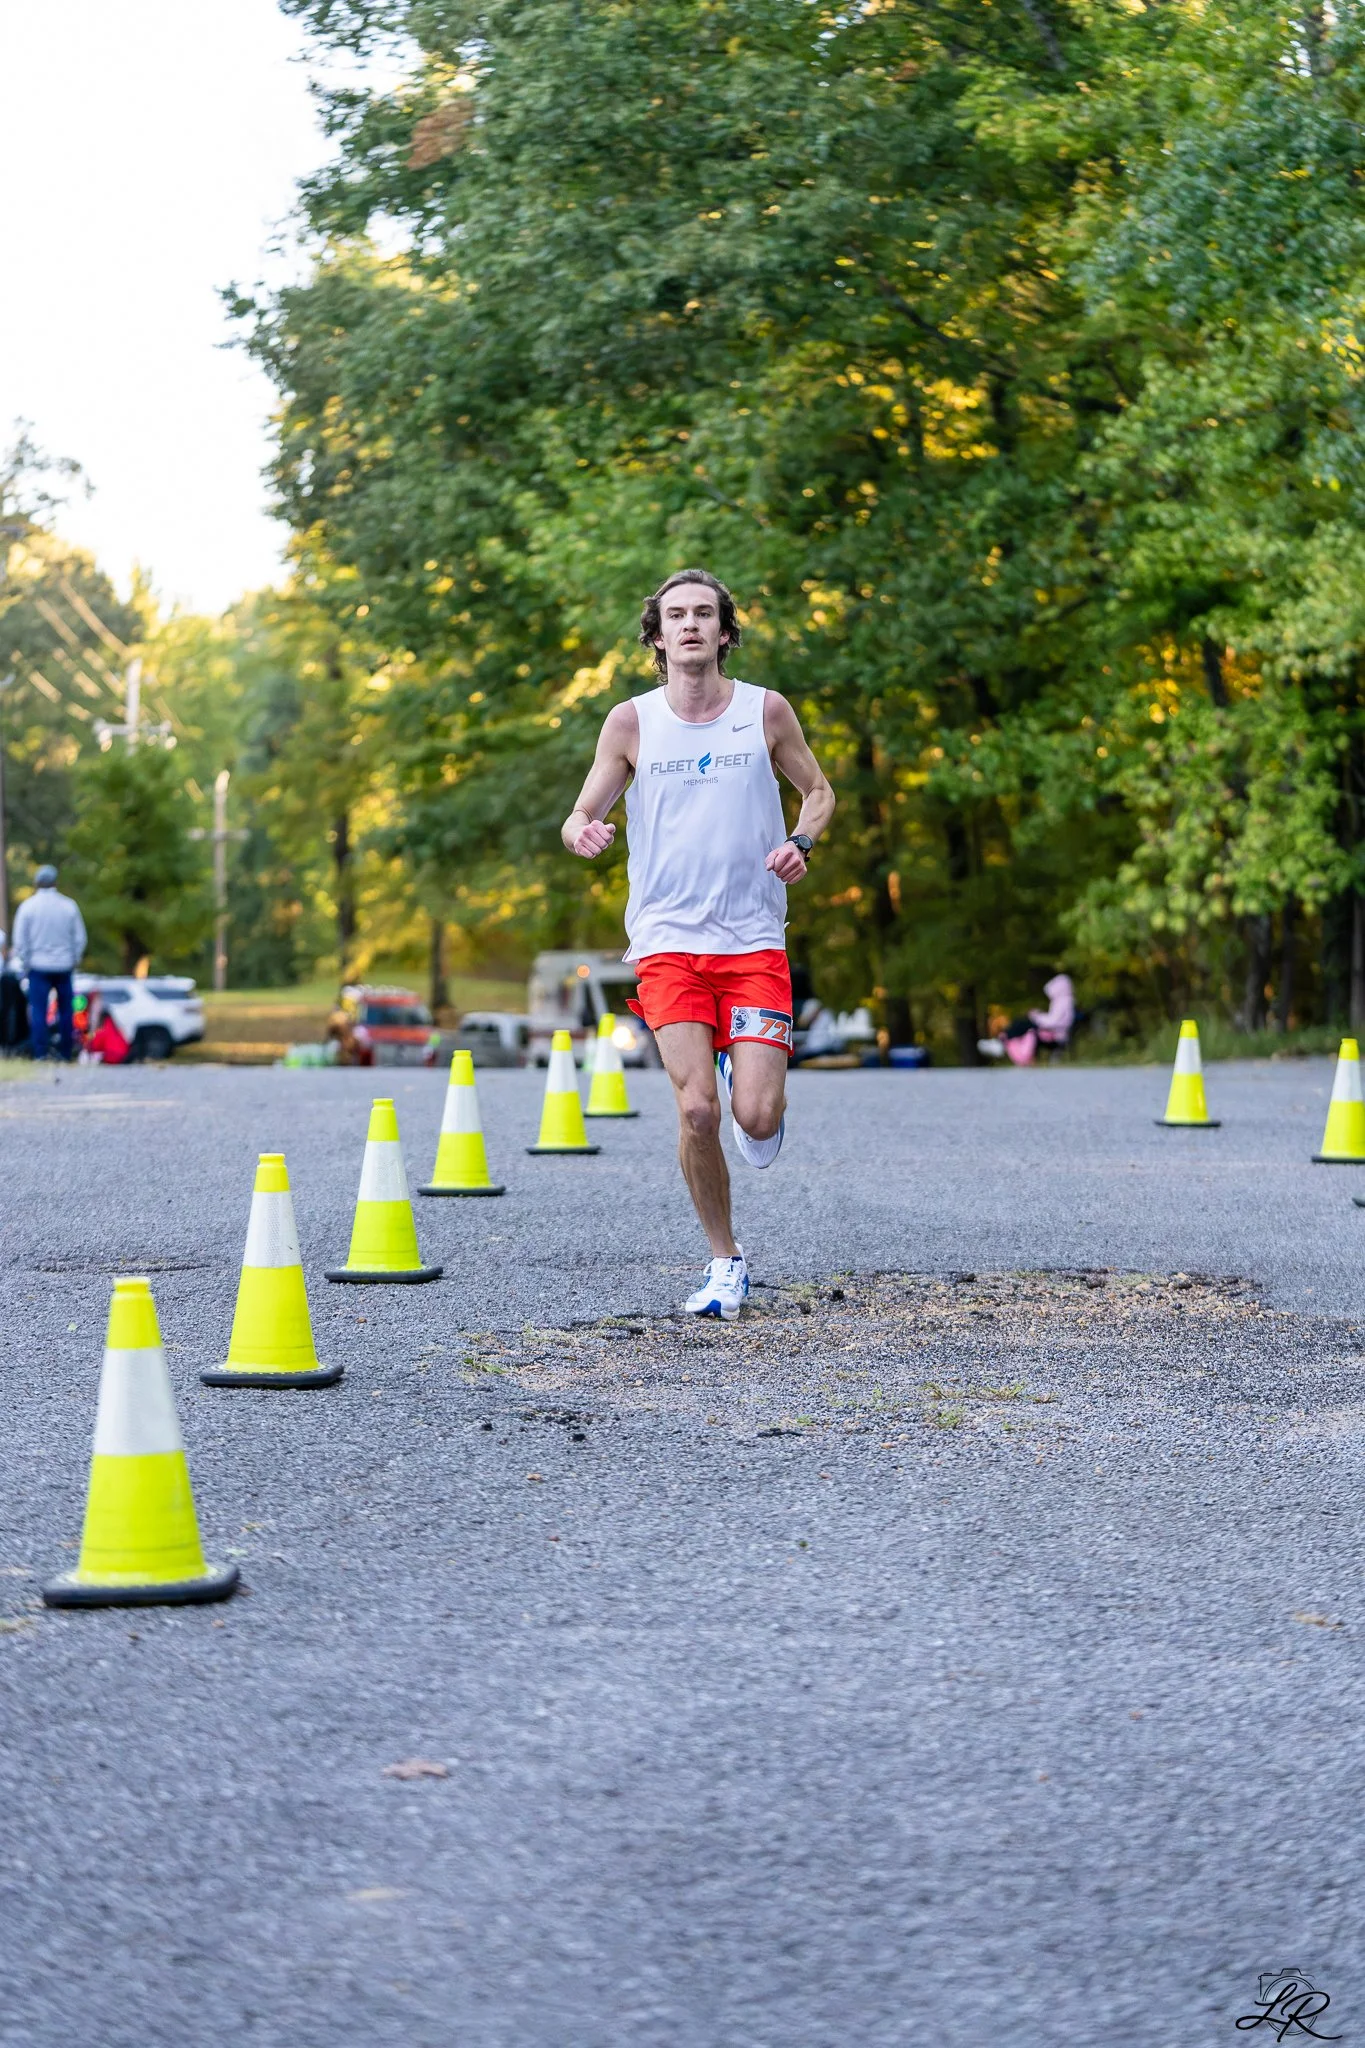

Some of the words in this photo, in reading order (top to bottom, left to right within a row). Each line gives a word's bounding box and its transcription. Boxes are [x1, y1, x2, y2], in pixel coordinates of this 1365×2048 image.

[650, 759, 695, 775] FLEET
[714, 753, 752, 768] FEET
[683, 776, 719, 787] MEMPHIS
